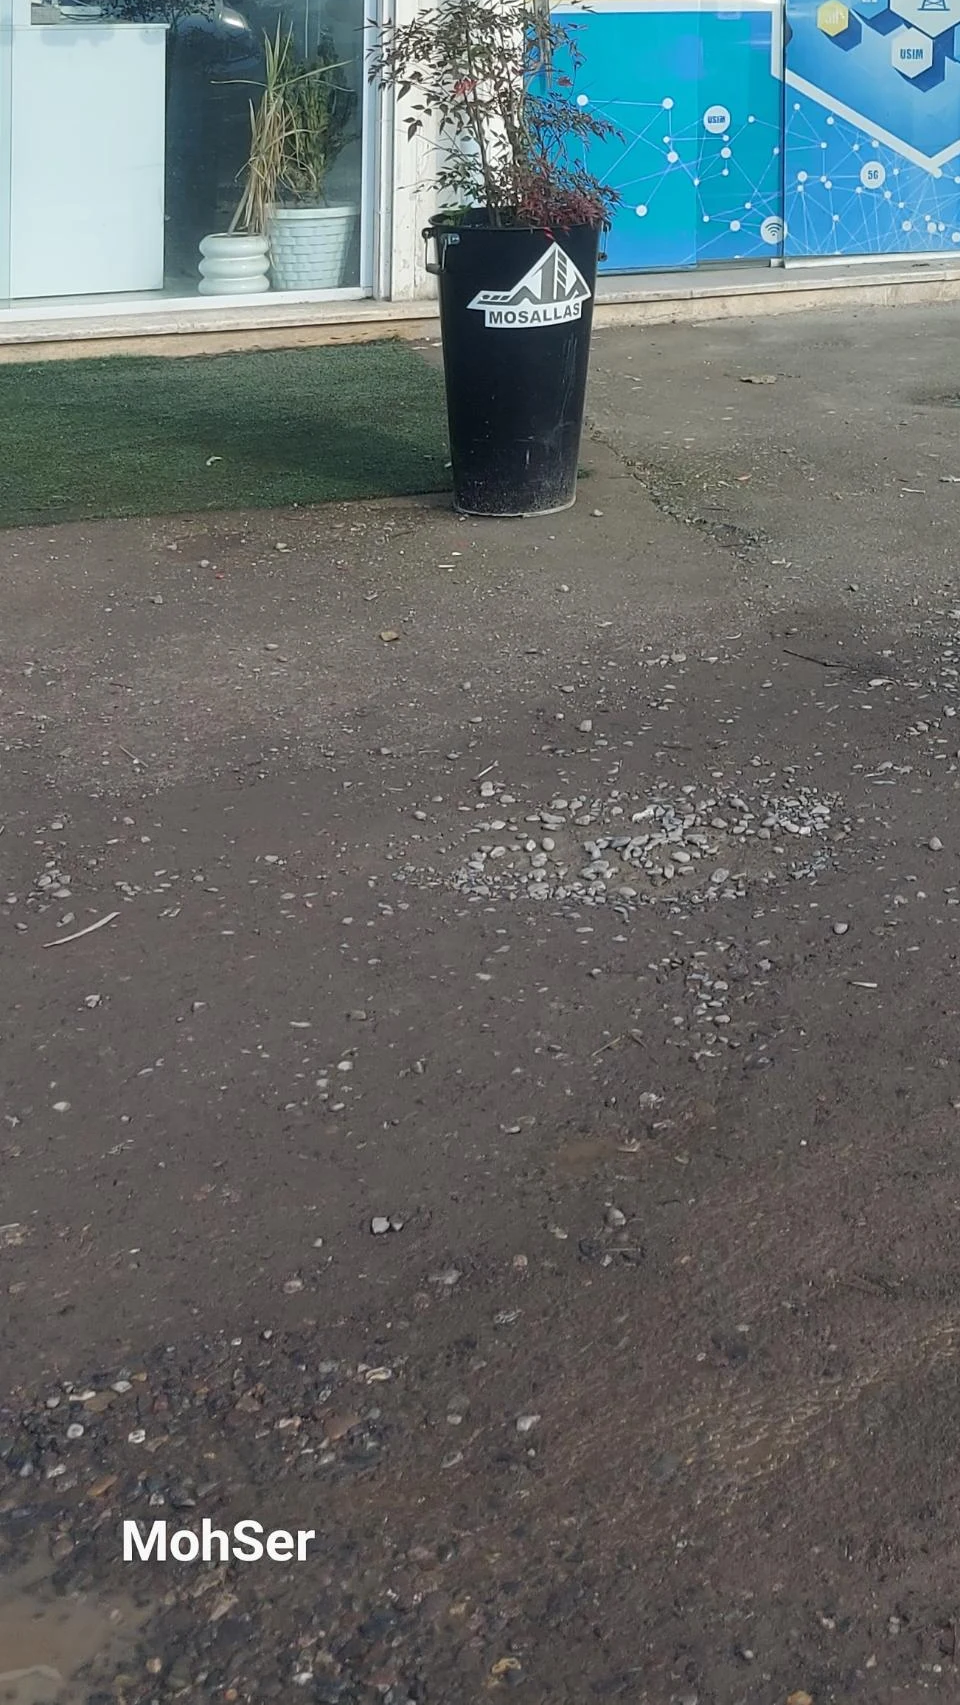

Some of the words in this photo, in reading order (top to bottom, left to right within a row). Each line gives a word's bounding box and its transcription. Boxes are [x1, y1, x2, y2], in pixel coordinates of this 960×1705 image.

[899, 48, 924, 62] USIM
[866, 169, 880, 181] 5G
[488, 301, 581, 325] MOSALLAS
